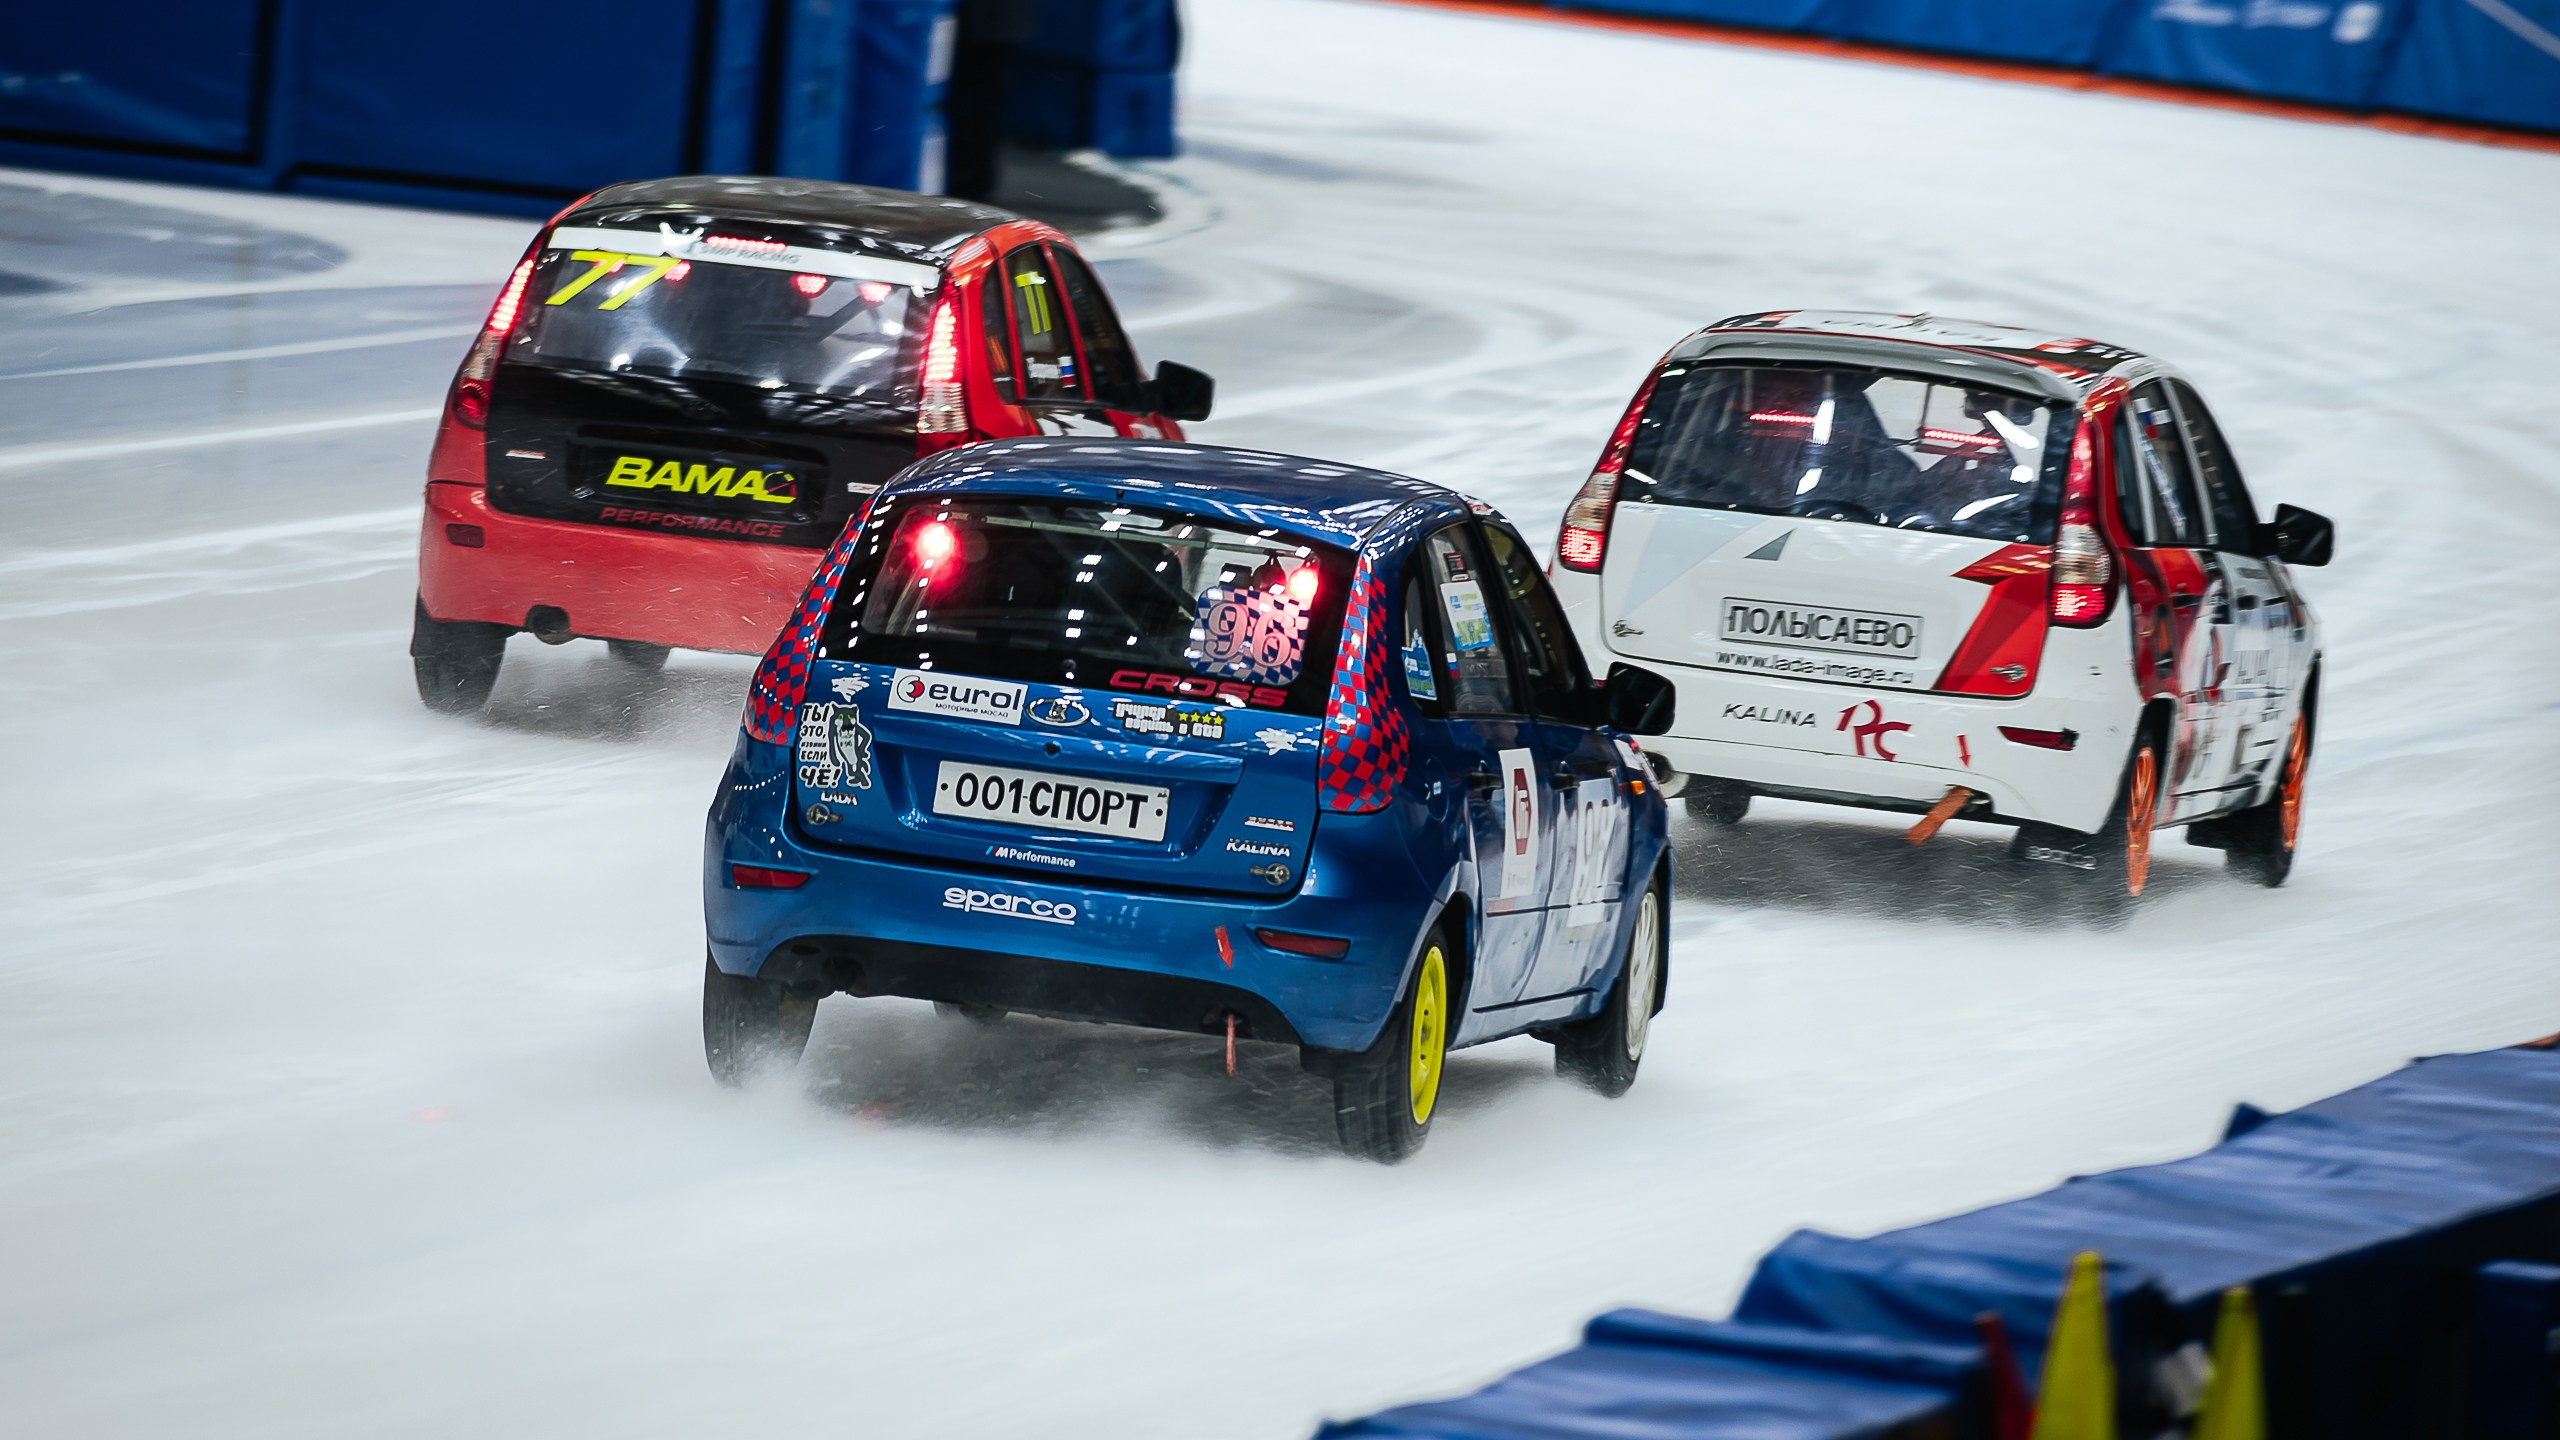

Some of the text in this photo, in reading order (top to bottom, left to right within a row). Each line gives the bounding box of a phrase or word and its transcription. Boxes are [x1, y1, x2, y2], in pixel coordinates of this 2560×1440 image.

[738, 250, 801, 265] RACING
[545, 250, 681, 311] 77
[1014, 271, 1053, 335] 77
[599, 506, 786, 539] PERFORMANCE
[1204, 601, 1293, 668] 96
[1728, 605, 1914, 649] ПОЛЫСАЕВО
[1716, 651, 1914, 684] www.lada-image.ru
[928, 683, 1022, 711] eurol
[1109, 669, 1288, 708] CROSS
[802, 704, 830, 722] ТЫ
[1722, 703, 1817, 729] KALINA
[801, 725, 827, 740] ЭТО,
[801, 750, 828, 761] ЕСЛИ
[801, 763, 841, 787] ЧЁ!
[820, 790, 858, 806] LADA
[1009, 848, 1076, 868] Performance
[1225, 838, 1291, 858] KALINA
[942, 886, 1077, 926] sparco
